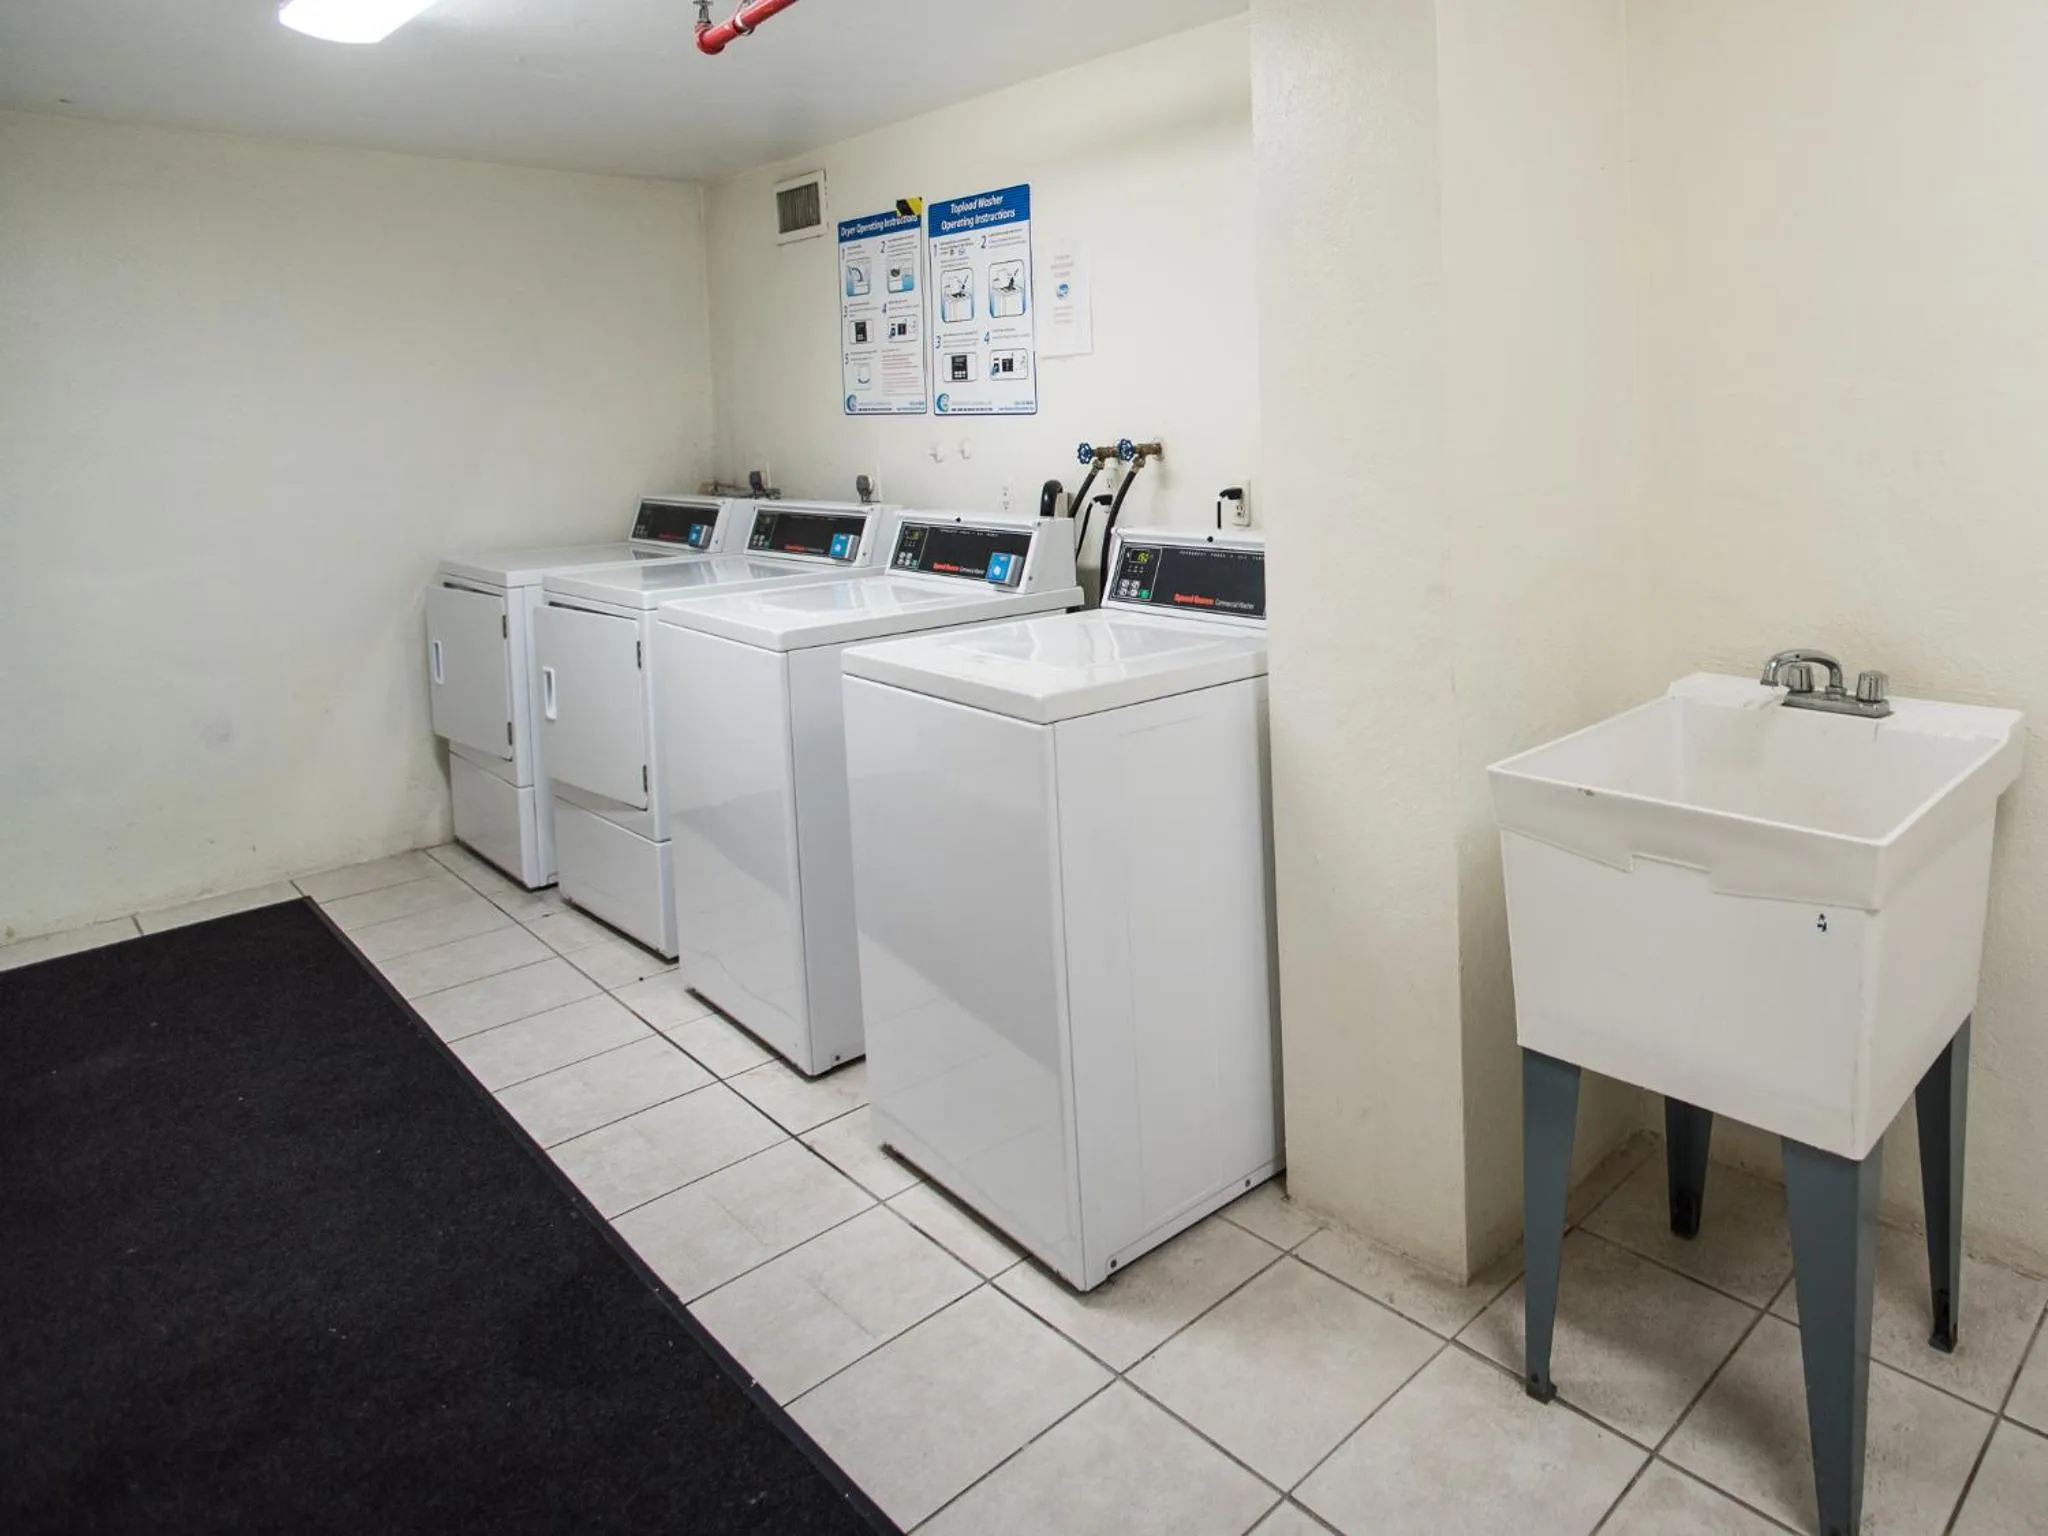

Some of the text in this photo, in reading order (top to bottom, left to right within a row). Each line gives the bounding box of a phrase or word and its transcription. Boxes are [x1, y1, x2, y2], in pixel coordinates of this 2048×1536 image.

[950, 194, 1004, 215] Topload Washer
[840, 215, 918, 238] Dryer Operating Instructions
[941, 208, 1016, 231] Operating Instructions
[980, 235, 987, 249] 2
[983, 331, 990, 344] 4
